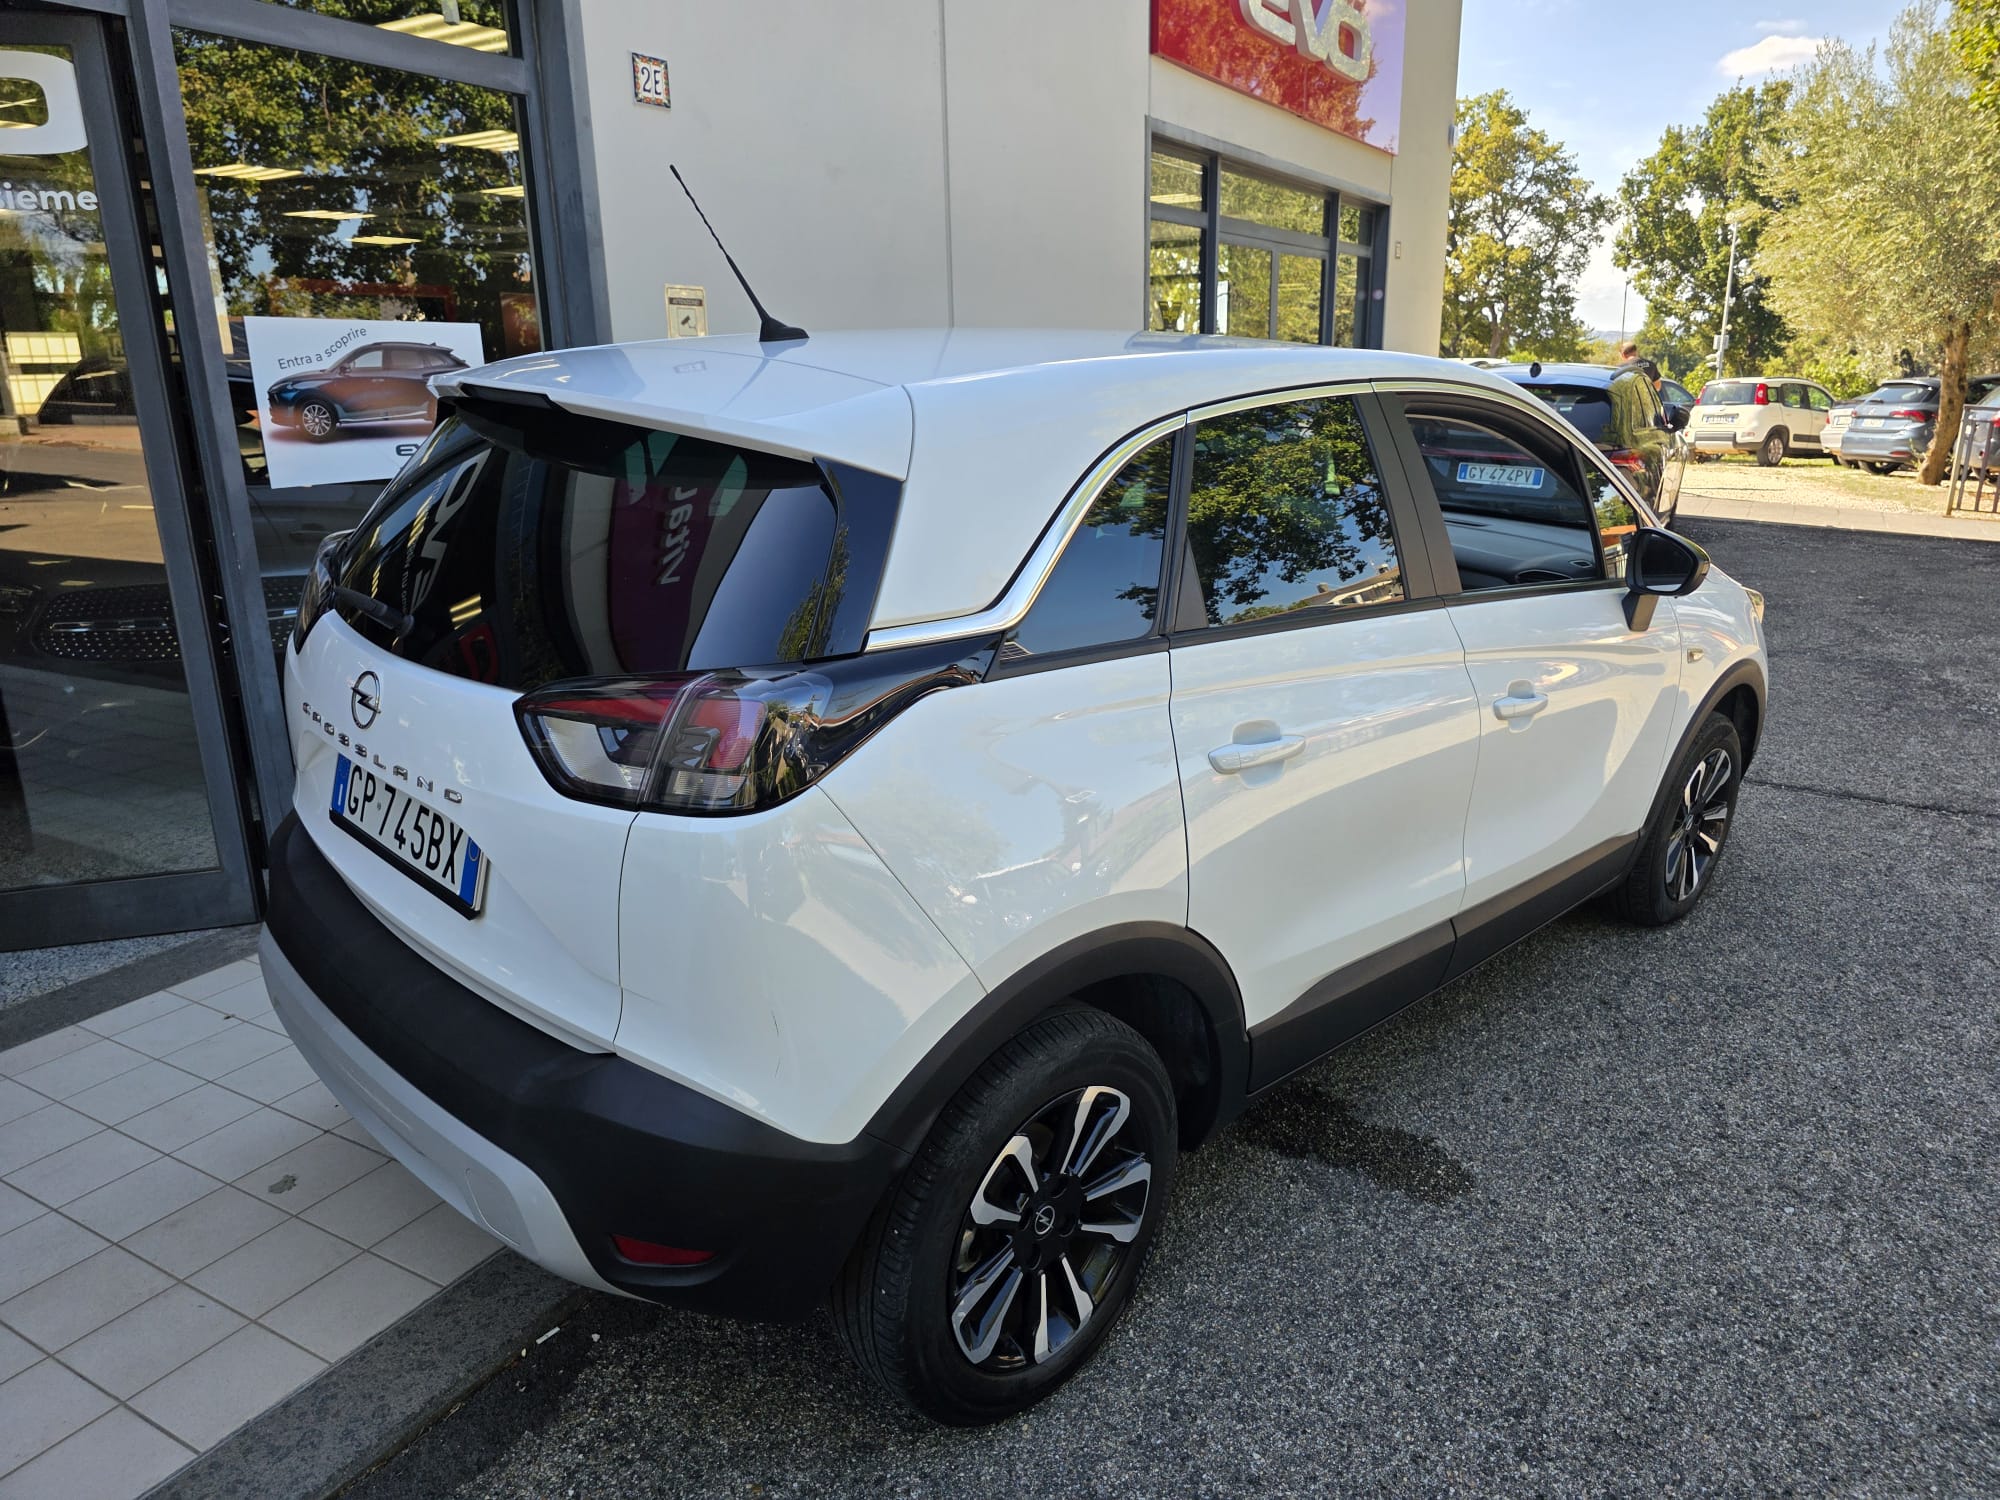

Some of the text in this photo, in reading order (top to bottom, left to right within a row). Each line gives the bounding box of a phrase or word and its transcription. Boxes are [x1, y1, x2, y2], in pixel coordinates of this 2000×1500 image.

[641, 66, 662, 95] 2E
[278, 327, 367, 370] Entra a scoprire
[1489, 468, 1533, 483] 474PV
[302, 702, 463, 804] CROSSLAND
[348, 764, 376, 823] GP
[378, 783, 464, 885] 745BX
